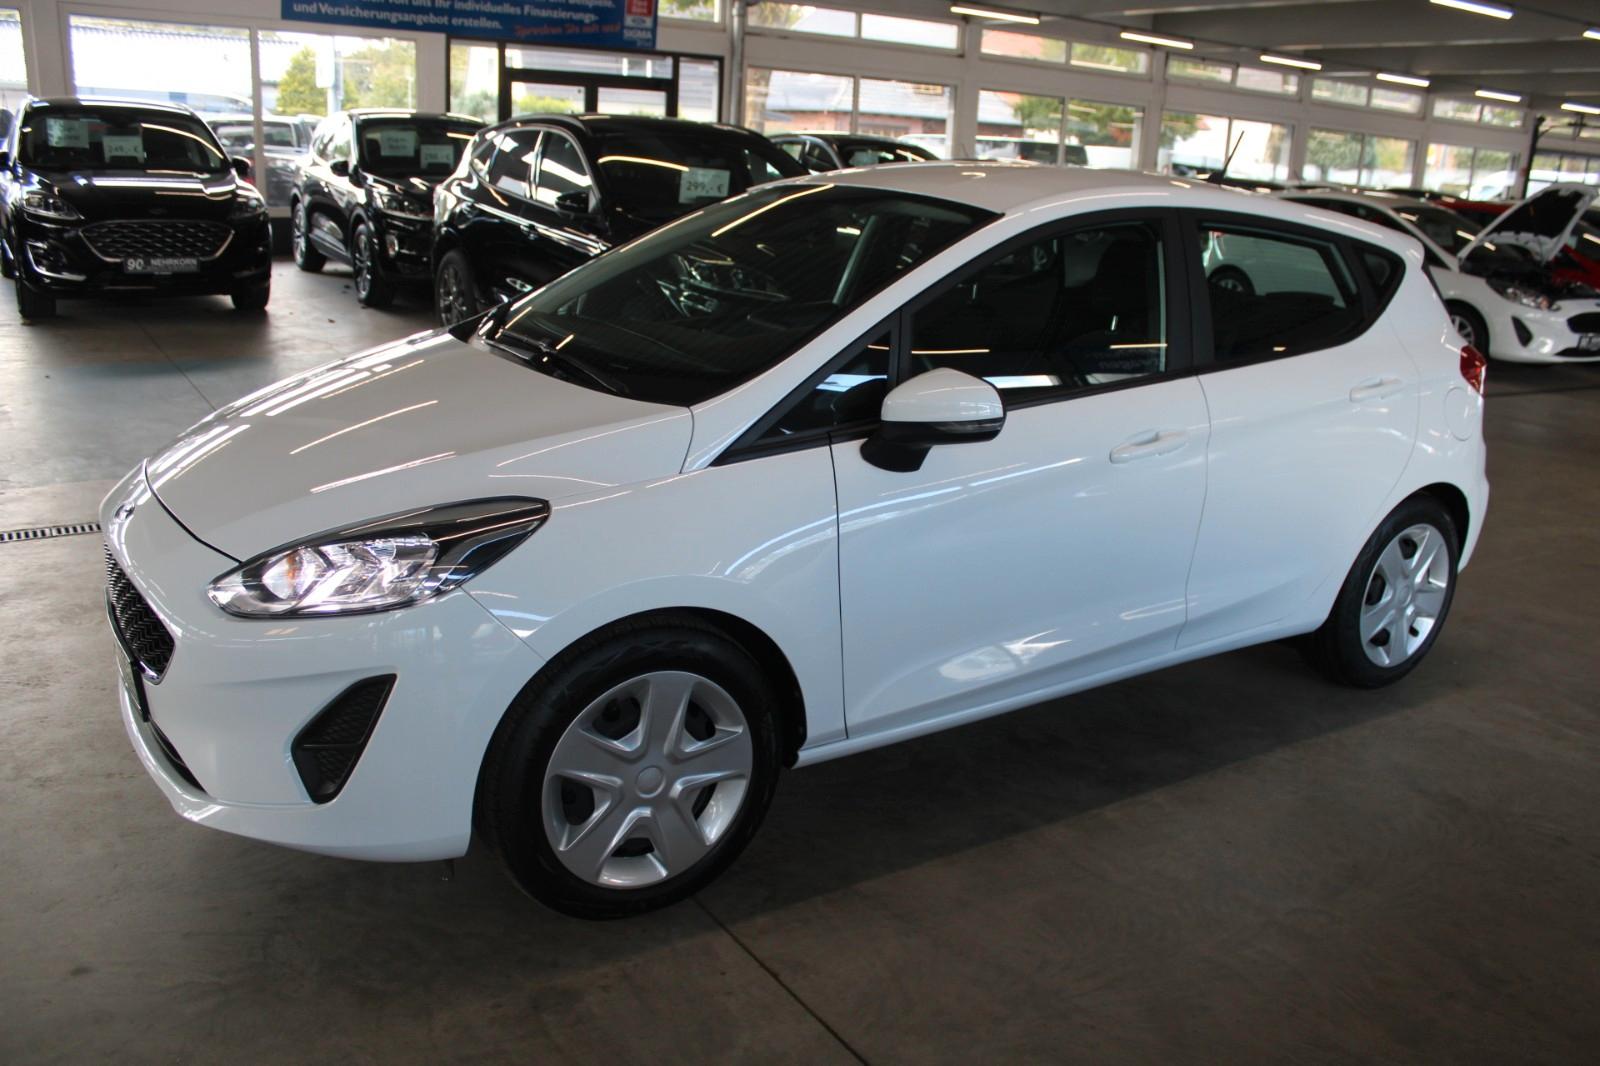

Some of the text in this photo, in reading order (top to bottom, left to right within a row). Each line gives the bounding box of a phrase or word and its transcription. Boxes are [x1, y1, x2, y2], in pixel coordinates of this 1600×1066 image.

[294, 3, 503, 29] und Versicherungsangebot erstellen.
[454, 0, 522, 16] individuelles
[524, 4, 600, 24] Finanzierungs-
[127, 258, 144, 271] 90
